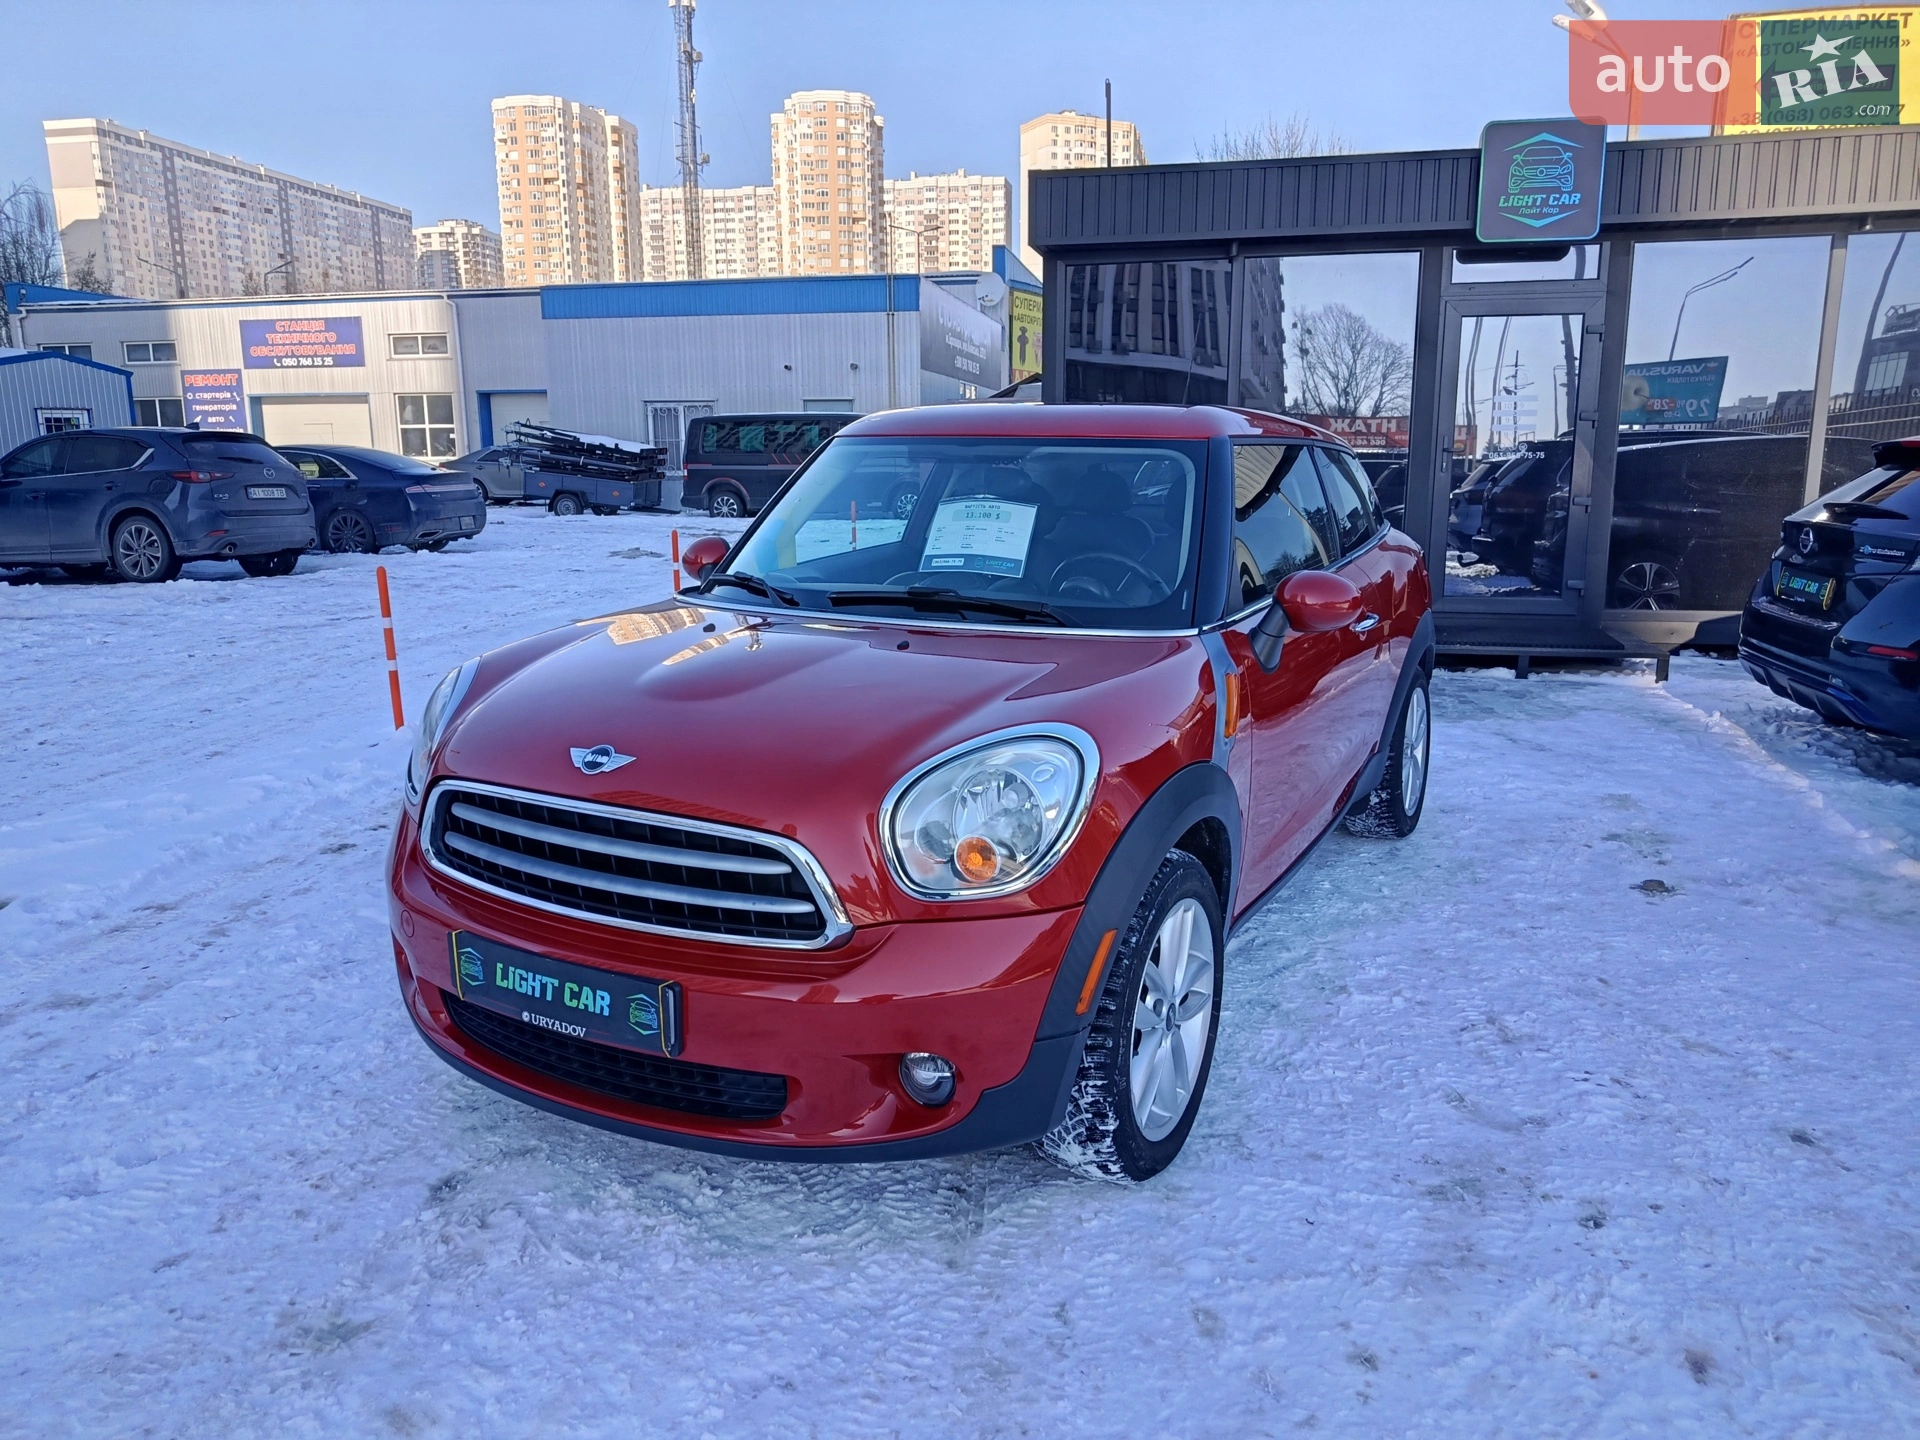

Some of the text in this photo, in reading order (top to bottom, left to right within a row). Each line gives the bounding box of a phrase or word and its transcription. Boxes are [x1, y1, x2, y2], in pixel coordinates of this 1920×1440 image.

[1498, 193, 1581, 207] LIGHT CAR
[275, 320, 325, 332] СТАНЦІЯ
[266, 332, 337, 344] ТЕХНІЧНОГО
[250, 344, 356, 357] ОБСЛУГОВУВАННЯ
[282, 357, 333, 366] 050 768 15 25
[184, 374, 238, 386] РЕМОНТ
[196, 391, 231, 400] стартерів
[192, 403, 237, 411] генераторів
[207, 415, 224, 423] авто
[495, 962, 611, 1017] LIGHT CAR
[531, 1013, 586, 1038] URYADOV
